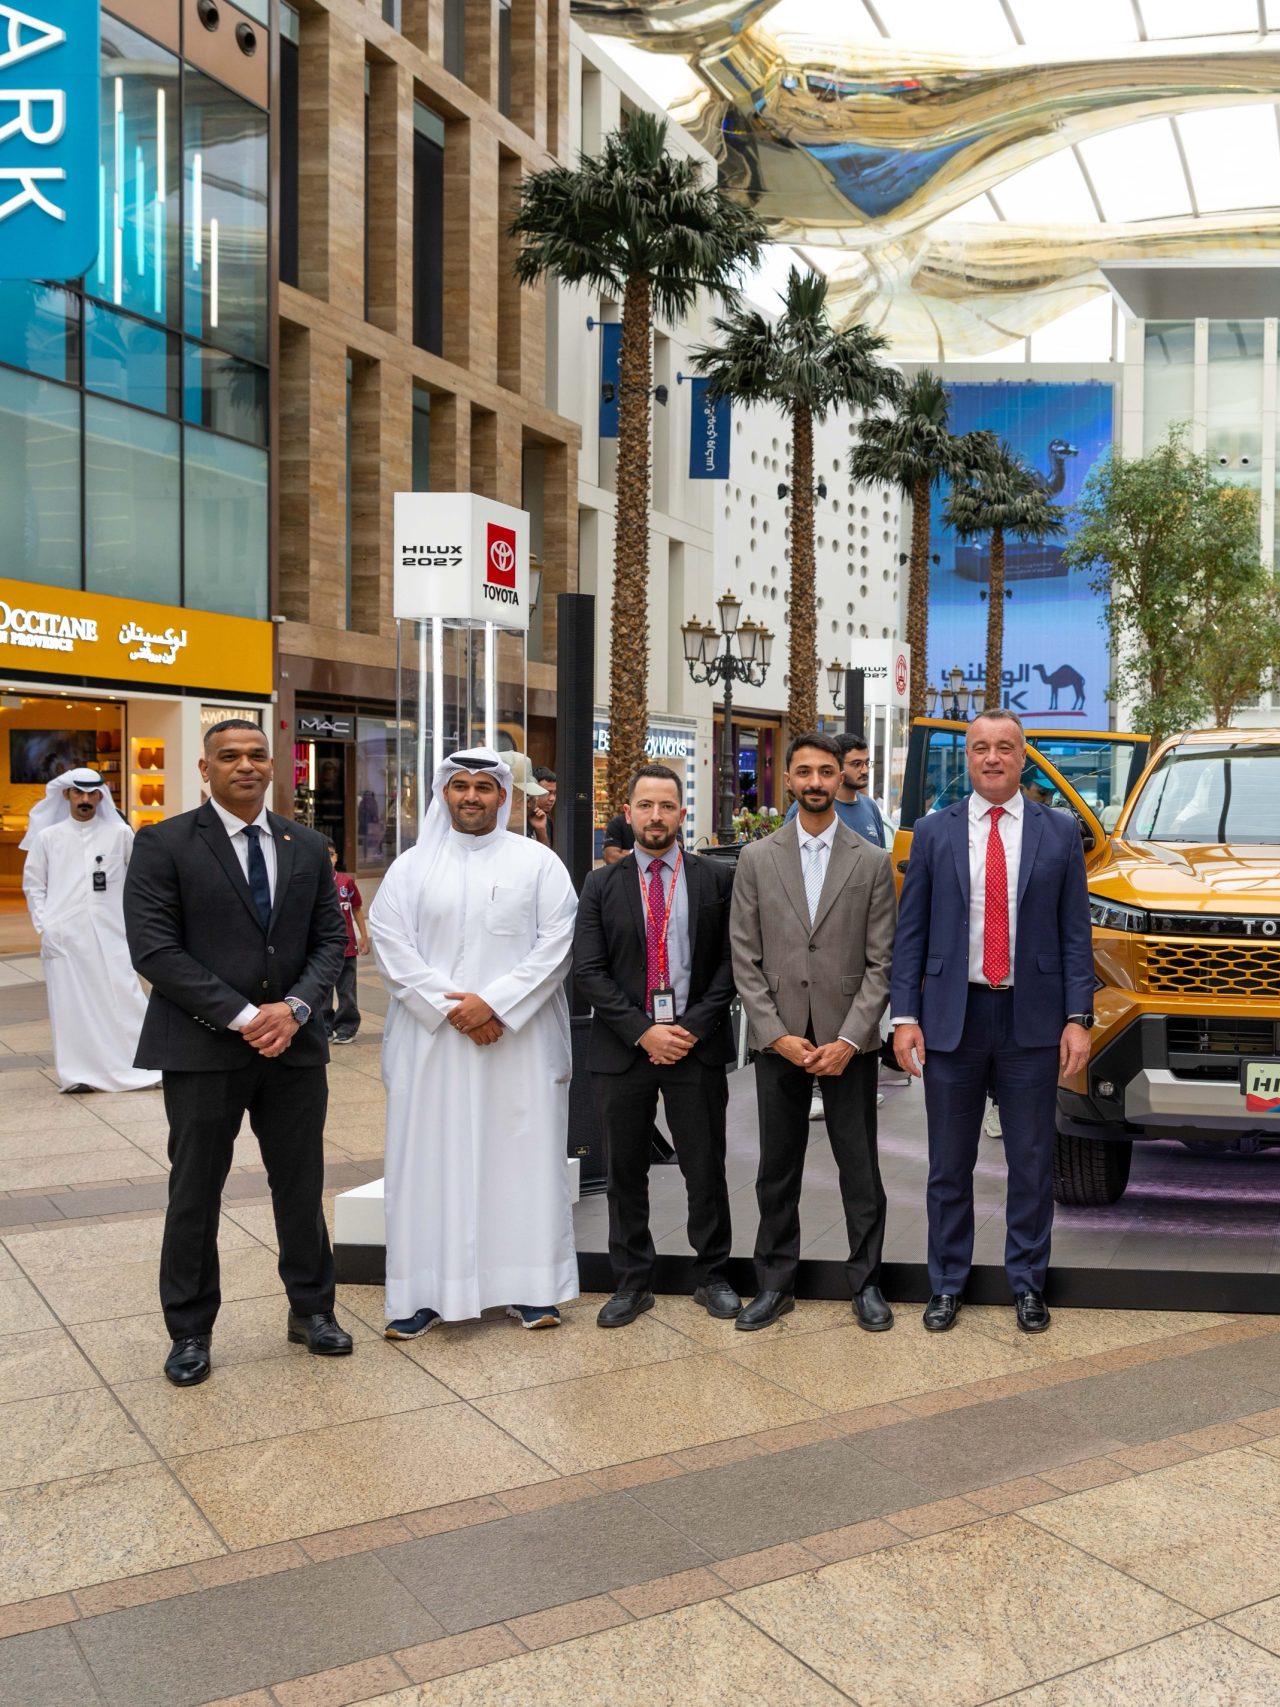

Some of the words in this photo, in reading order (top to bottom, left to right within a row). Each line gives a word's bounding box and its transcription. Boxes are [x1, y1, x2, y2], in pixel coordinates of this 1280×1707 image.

[402, 545, 462, 554] HILUX
[402, 557, 463, 566] 2027
[483, 584, 519, 605] TOYOTA
[118, 622, 187, 650] لوكسيتان
[301, 718, 350, 733] MAC
[658, 736, 687, 757] Works
